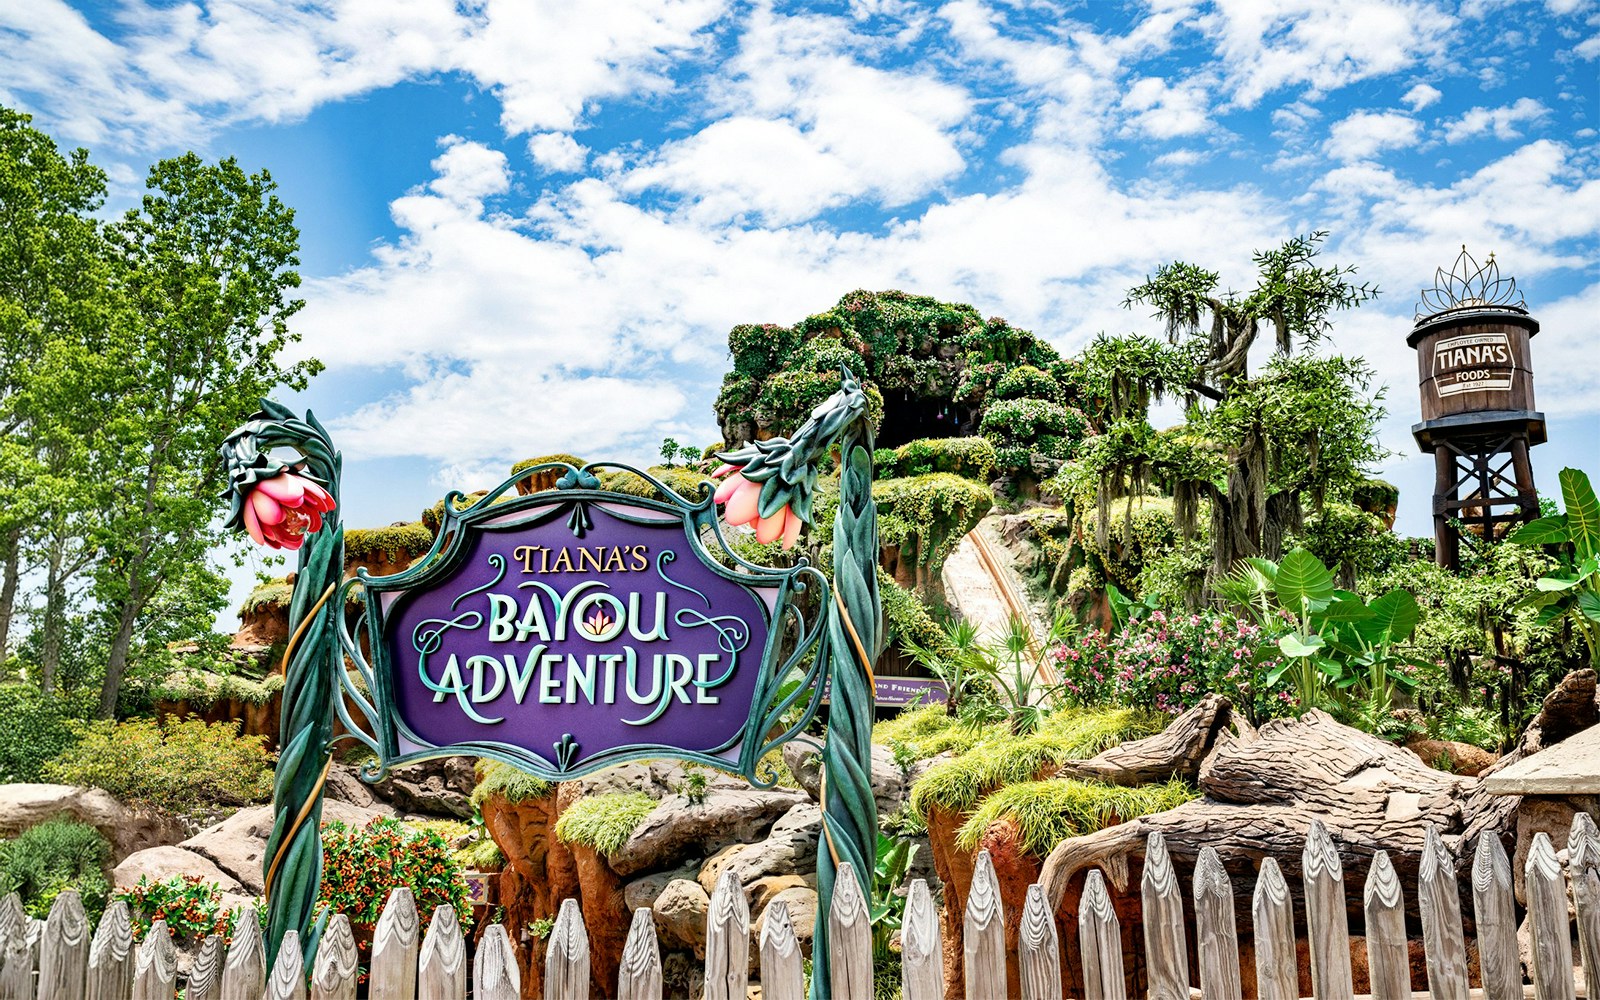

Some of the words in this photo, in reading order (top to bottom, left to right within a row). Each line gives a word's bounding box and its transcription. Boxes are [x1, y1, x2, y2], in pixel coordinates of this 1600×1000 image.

[1437, 345, 1508, 370] TIANA'S
[1456, 369, 1491, 382] FOODS
[513, 544, 649, 573] TIANA'S
[486, 580, 671, 643] BAYOU
[432, 644, 721, 726] ADVENTURE
[891, 683, 924, 694] FRIEND
